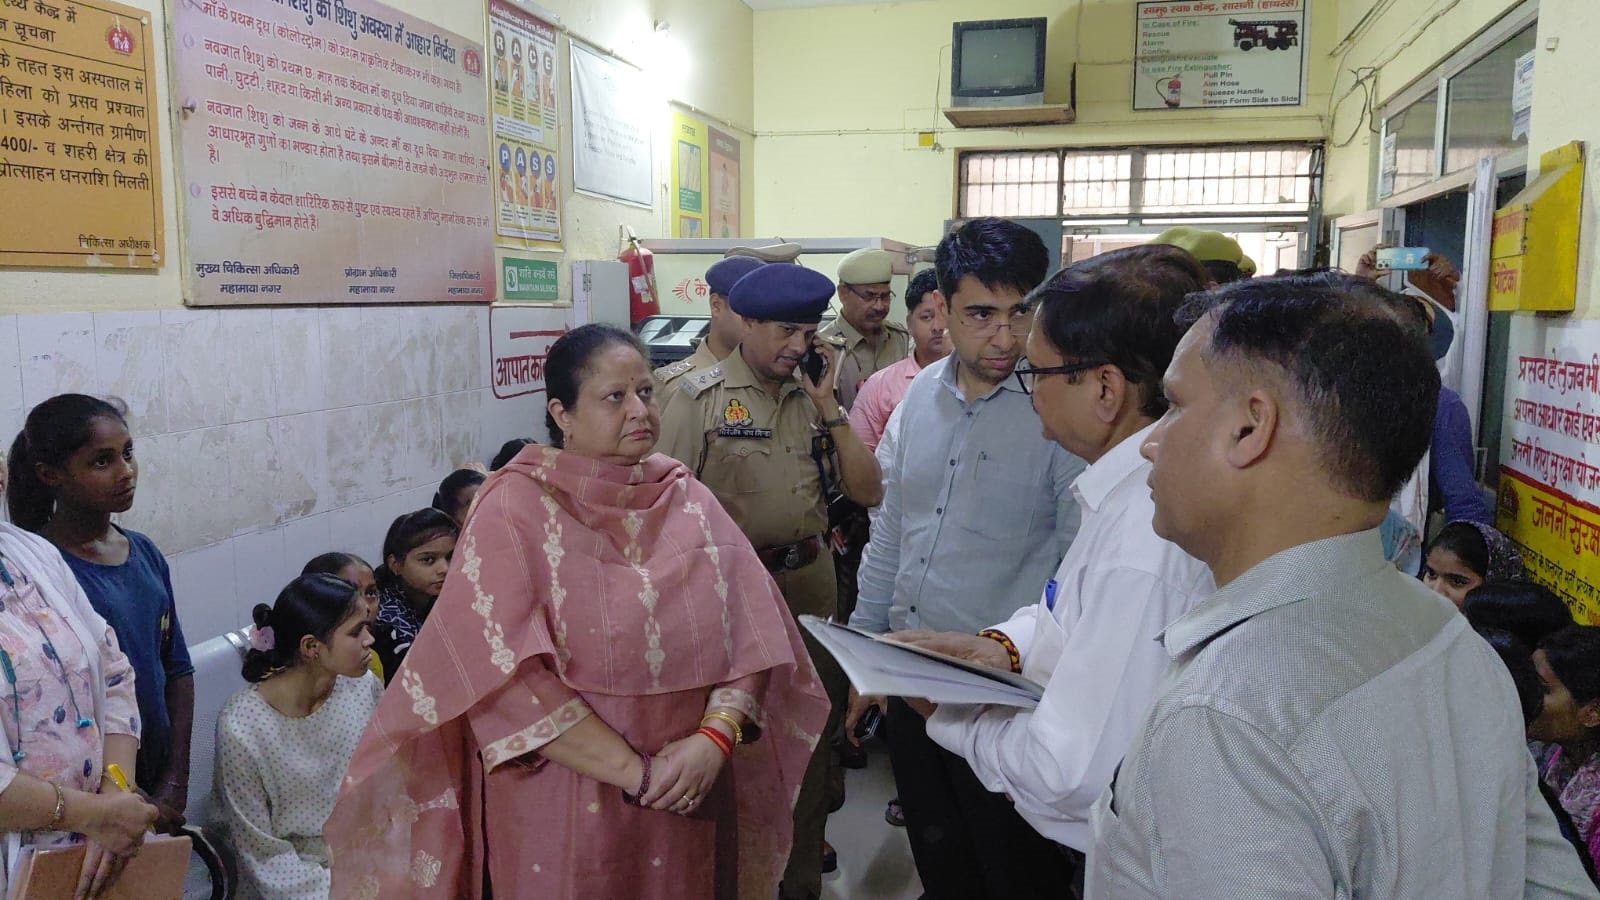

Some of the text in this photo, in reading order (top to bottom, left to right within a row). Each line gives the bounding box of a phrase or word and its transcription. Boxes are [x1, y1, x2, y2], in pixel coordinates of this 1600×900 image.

[64, 6, 77, 23] में
[219, 2, 229, 20] के
[230, 10, 254, 30] प्रथम
[256, 19, 270, 37] दूध
[13, 21, 56, 42] सूचना
[334, 0, 358, 40] शिशु
[360, 14, 393, 42] अवस्था
[395, 21, 404, 46] में
[405, 31, 432, 57] आहार
[432, 33, 456, 65] निर्देश
[204, 39, 241, 60] नवजात
[243, 45, 265, 72] शिशु
[266, 52, 278, 71] को
[281, 59, 302, 77] प्रथम
[16, 56, 48, 76] तहत
[52, 63, 74, 81] इस
[79, 69, 130, 92] अस्पताल
[134, 76, 143, 96] में
[1203, 71, 1233, 79] Pull Pin
[1203, 80, 1240, 88] Aim Hose
[0, 75, 32, 100] हिला
[41, 86, 59, 104] को
[68, 93, 99, 111] प्रसव
[266, 79, 286, 96] शहद
[287, 84, 298, 97] या
[300, 82, 321, 104] किसी
[322, 90, 332, 105] भी
[1202, 88, 1264, 98] Squeeze Handle
[1202, 98, 1228, 106] Sweep
[1251, 96, 1269, 104] Side
[1280, 95, 1299, 103] Side
[14, 109, 51, 129] इसके
[110, 122, 147, 143] ग्रामीण
[207, 100, 243, 120] नवजात
[247, 104, 269, 130] शिशु
[272, 111, 285, 128] को
[288, 116, 308, 132] जन्म
[311, 117, 321, 134] के
[324, 123, 341, 139] आधे
[44, 141, 56, 156] व
[63, 141, 97, 161] शहरी
[105, 144, 126, 165] क्षेत्र
[133, 148, 148, 167] की
[208, 125, 256, 149] आधारभूत
[279, 137, 291, 152] का
[320, 141, 337, 160] होता
[516, 152, 525, 167] A
[60, 167, 109, 187] धनराशि
[113, 169, 149, 190] मिलती
[210, 182, 237, 201] इससे
[238, 185, 258, 202] बच्चे
[260, 191, 268, 203] न
[270, 187, 293, 206] केवल
[222, 207, 252, 224] अधिक
[254, 209, 292, 231] बुद्धिमान
[195, 263, 220, 278] मुख्य
[223, 260, 261, 276] चिकित्सा
[264, 262, 300, 277] अधिकारी
[220, 283, 258, 295] महामाया
[261, 284, 281, 294] नगर
[496, 344, 552, 388] आपातका
[1518, 356, 1547, 384] प्रसव
[1514, 398, 1538, 427] अपना
[1532, 496, 1568, 541] जननी
[1569, 514, 1600, 557] सुरक्ष
